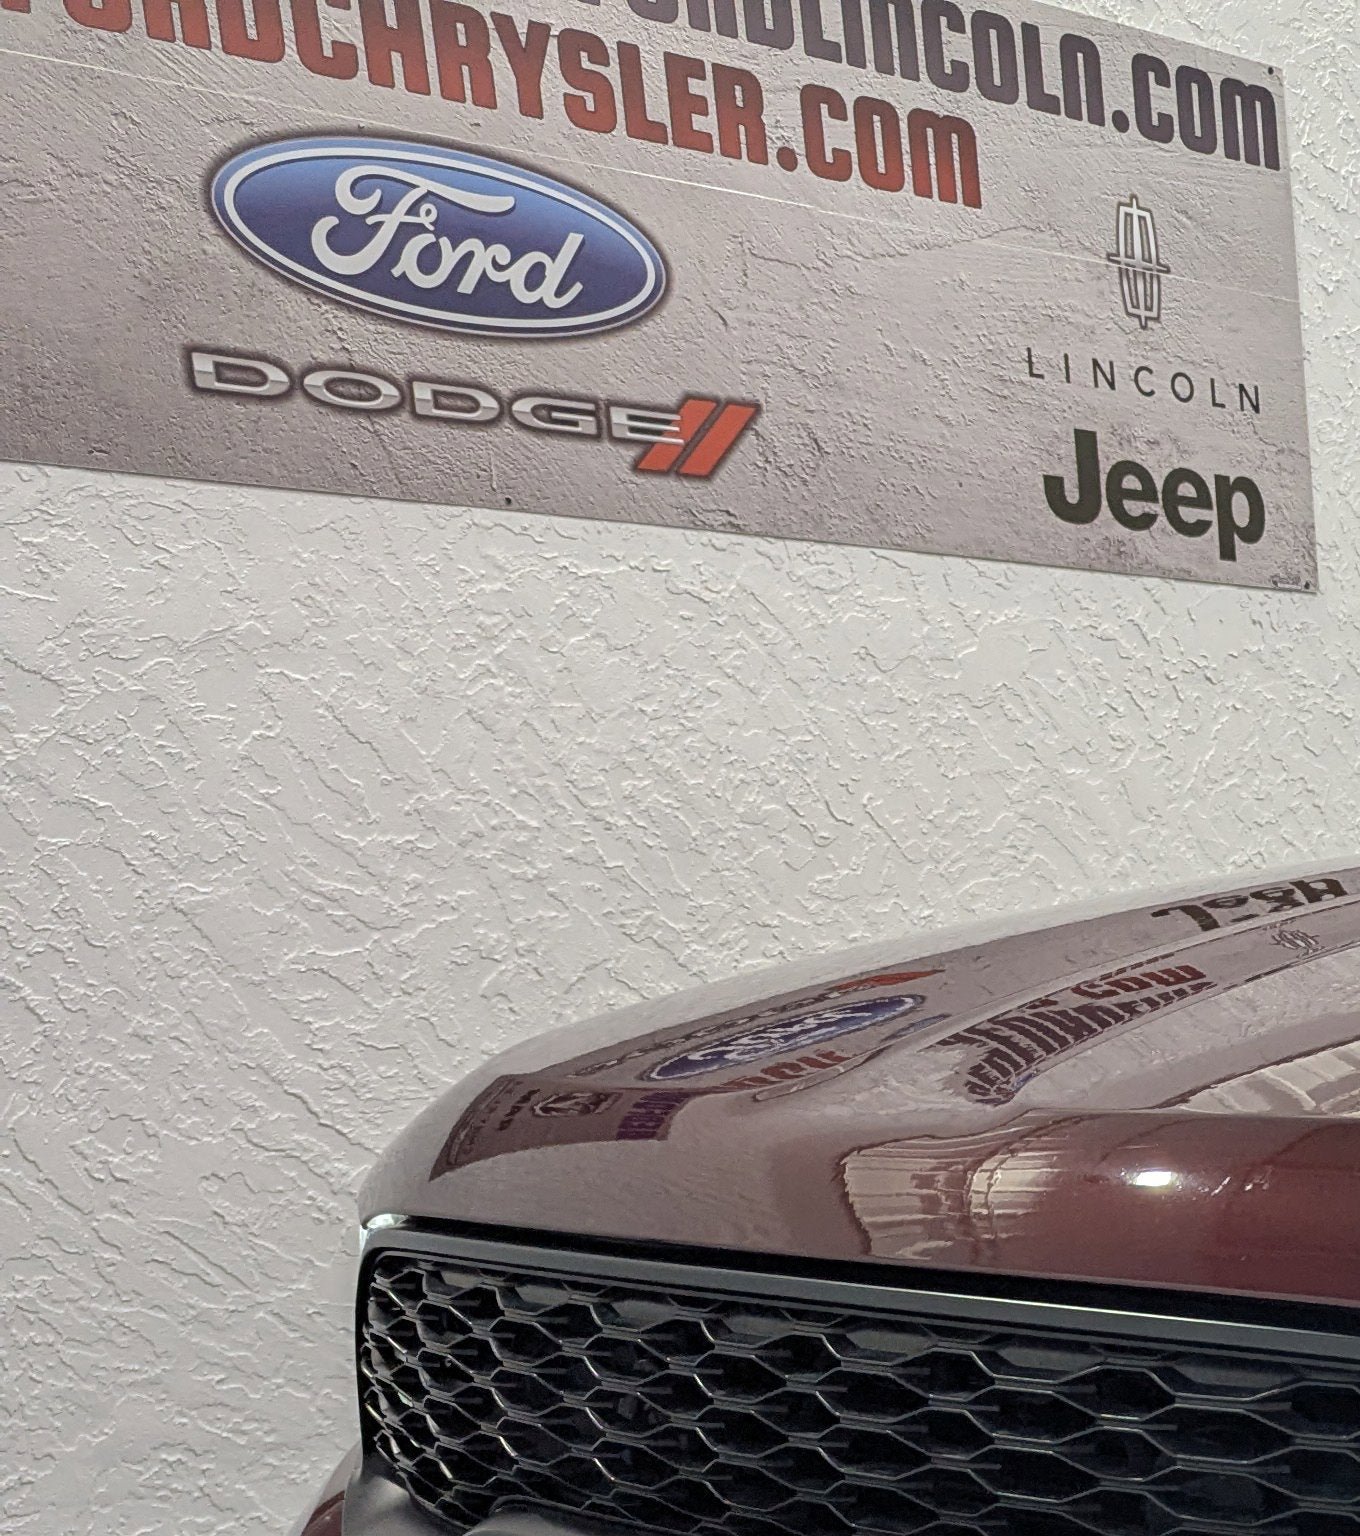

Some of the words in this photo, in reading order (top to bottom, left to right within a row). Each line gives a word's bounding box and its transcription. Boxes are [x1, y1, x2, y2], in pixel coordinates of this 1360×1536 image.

[0, 0, 982, 209] DCHRYSLER.COM
[577, 0, 1281, 171] LINCOLN.COM
[311, 165, 584, 308] Ford
[191, 351, 684, 444] DODGE
[1026, 347, 1260, 414] LINCOLN
[1043, 428, 1265, 562] Jeep
